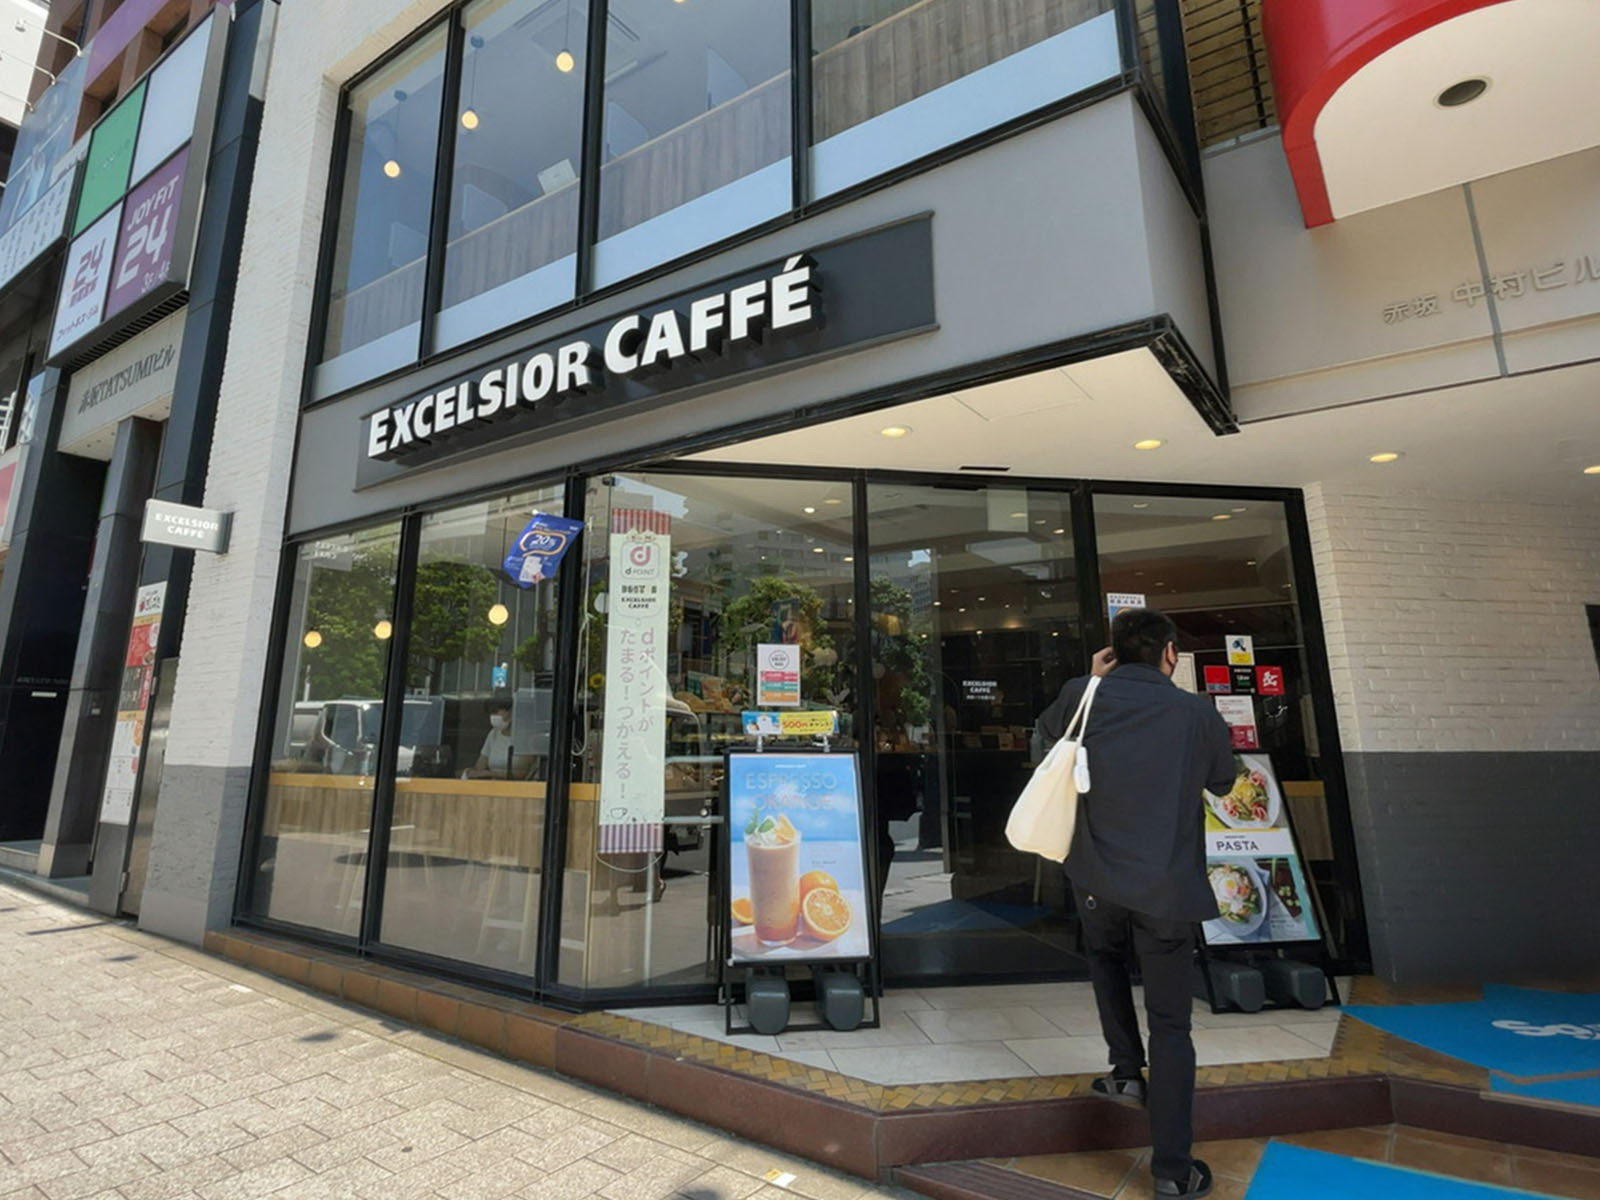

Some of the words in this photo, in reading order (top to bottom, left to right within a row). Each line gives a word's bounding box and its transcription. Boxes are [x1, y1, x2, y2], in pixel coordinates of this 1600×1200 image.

[72, 237, 106, 292] 24
[116, 205, 172, 289] 24
[367, 340, 591, 457] EXCELSIOR
[604, 254, 812, 373] CAFFÉ
[155, 512, 219, 531] EXCELSIOR
[1216, 840, 1260, 851] PASTA
